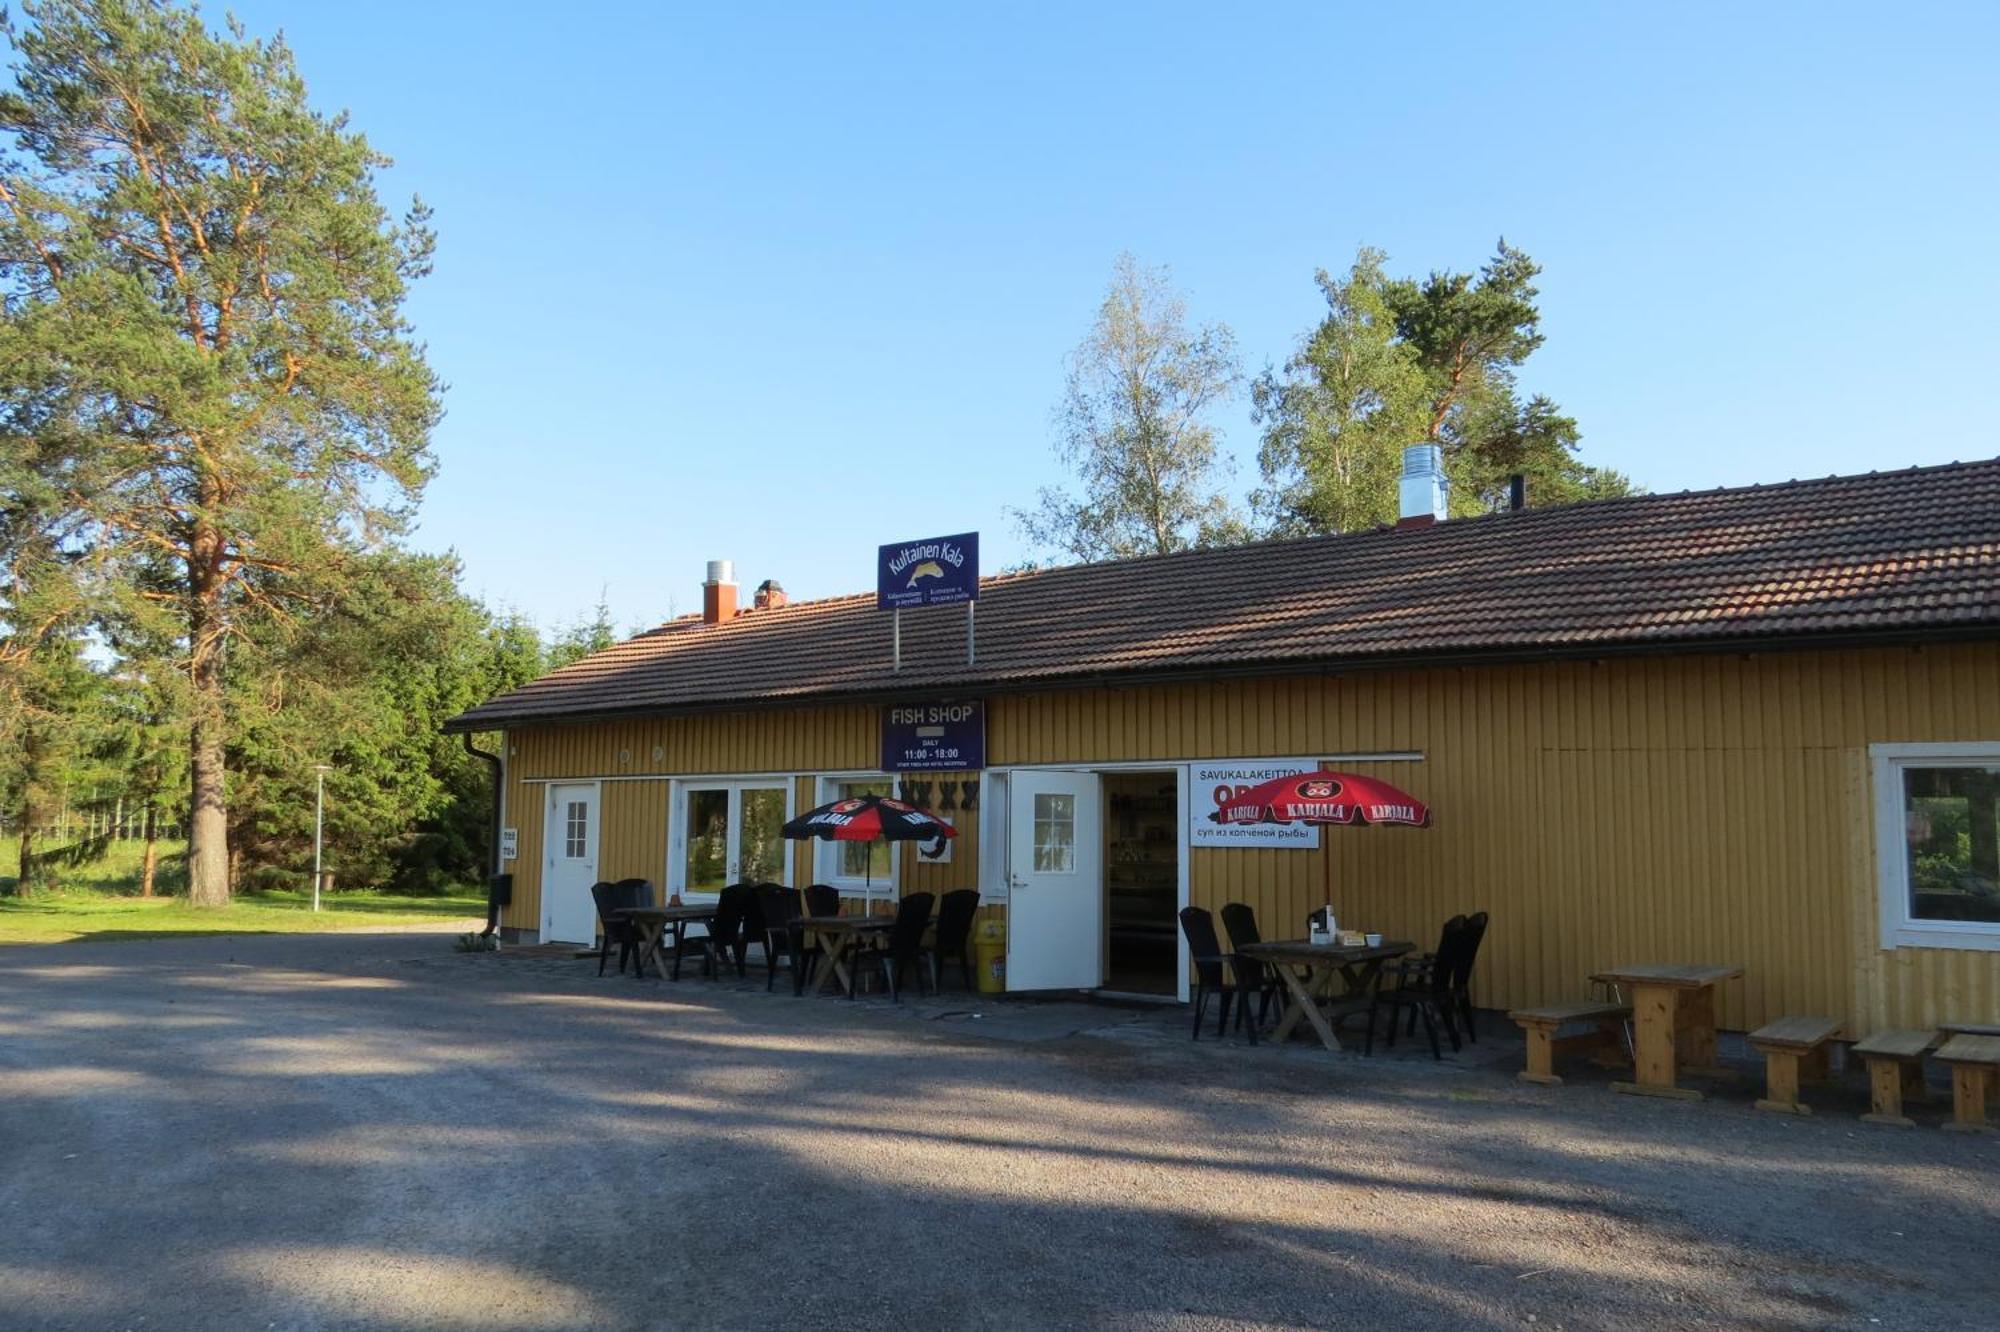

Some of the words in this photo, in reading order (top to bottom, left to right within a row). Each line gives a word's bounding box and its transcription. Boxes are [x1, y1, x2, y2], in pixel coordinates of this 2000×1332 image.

[889, 544, 939, 575] Kultainen
[941, 543, 964, 568] Kala
[892, 708, 924, 724] FISH
[929, 706, 973, 723] SHOP
[922, 739, 939, 747] DAILY
[905, 749, 927, 760] 11:00
[935, 748, 958, 759] 18:00
[1287, 803, 1344, 818] KARJALA
[1371, 804, 1415, 820] KARJALA
[1197, 829, 1214, 839] суп
[1278, 828, 1309, 839] рыбы
